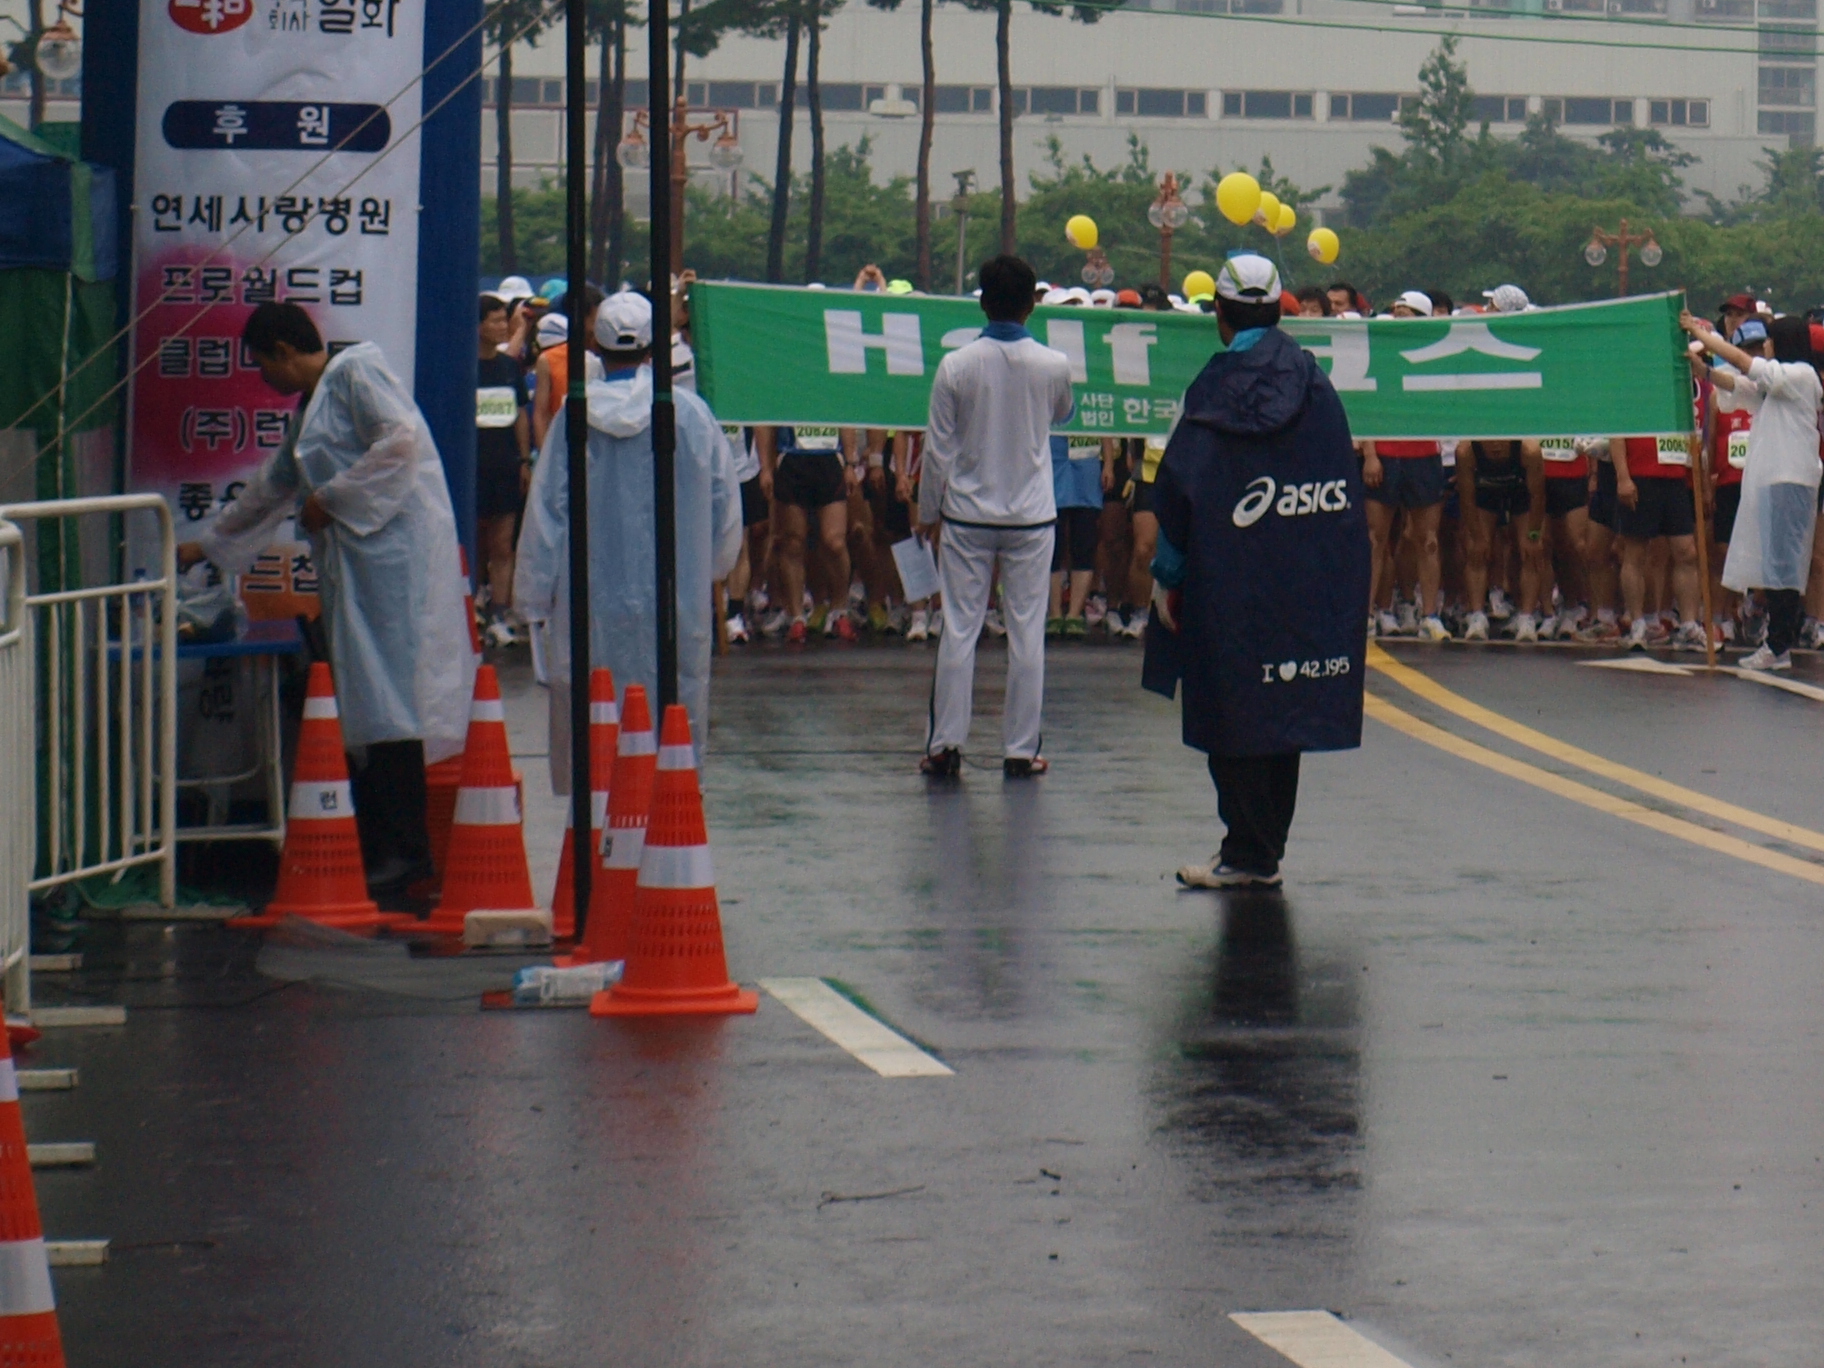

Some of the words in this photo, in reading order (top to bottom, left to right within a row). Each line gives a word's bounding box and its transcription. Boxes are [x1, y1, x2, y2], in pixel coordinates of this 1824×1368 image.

[152, 193, 392, 236] 연세사랑병원
[161, 265, 363, 306] 프로월드컵
[824, 309, 1158, 386] Hlf
[1081, 393, 1114, 409] 사단
[1300, 656, 1350, 680] 42.195
